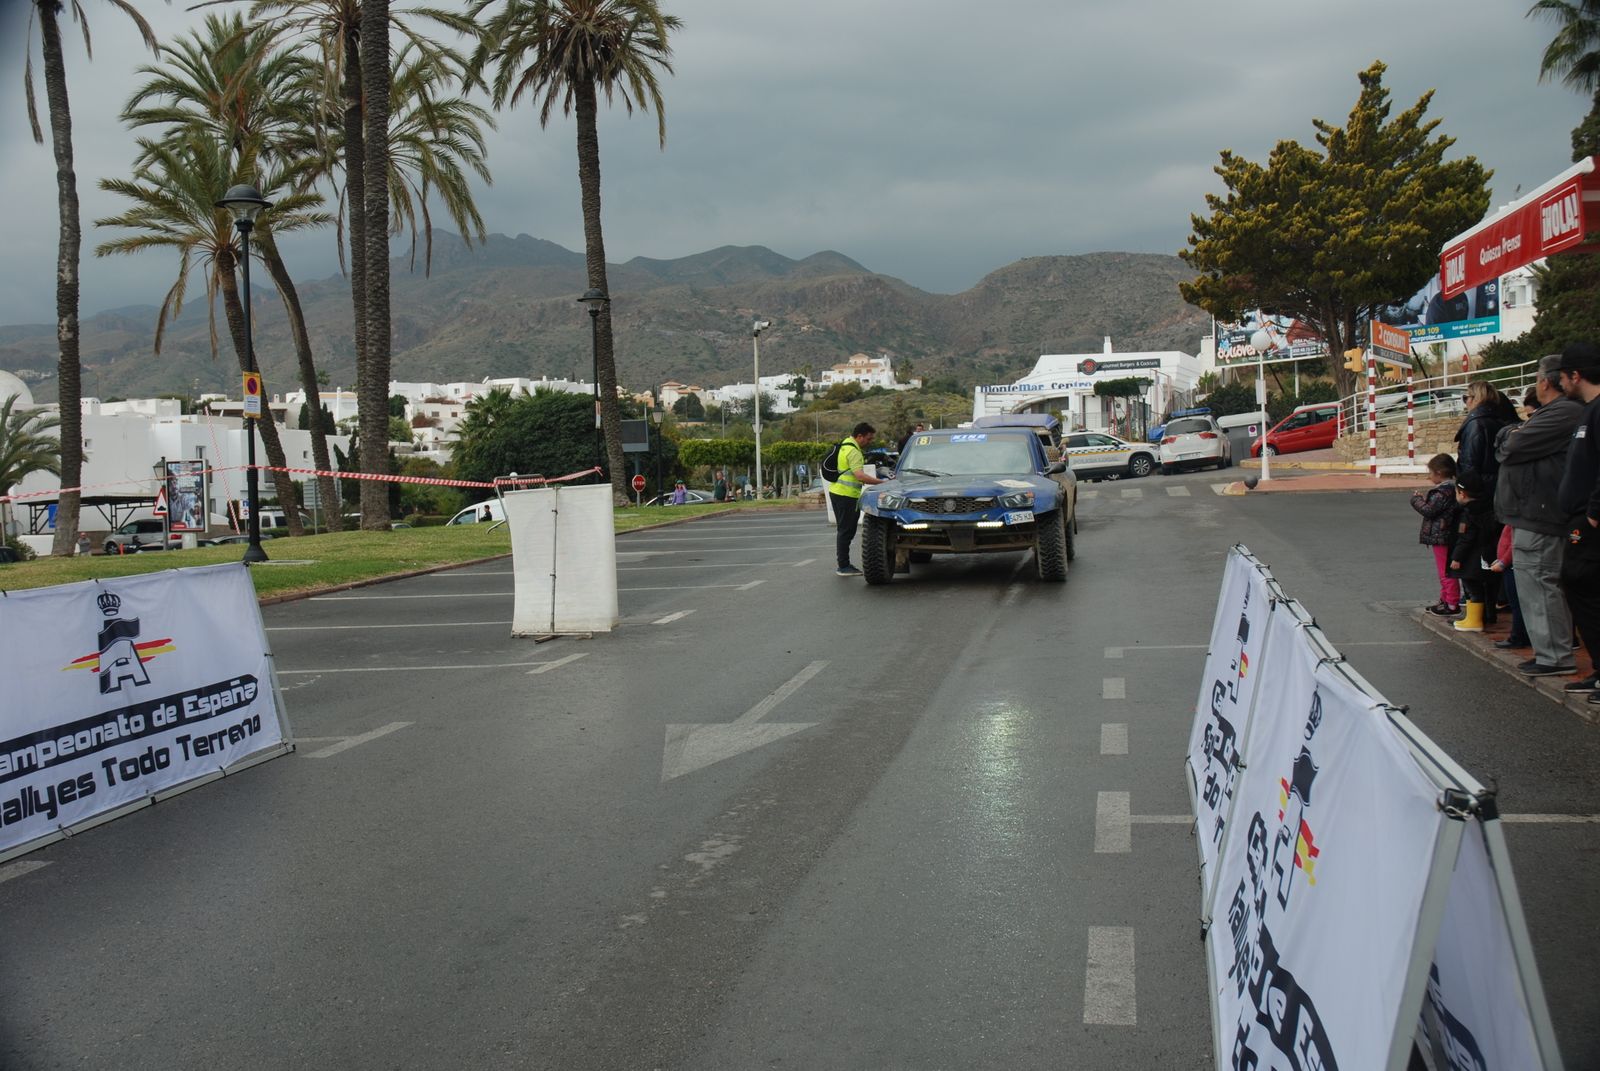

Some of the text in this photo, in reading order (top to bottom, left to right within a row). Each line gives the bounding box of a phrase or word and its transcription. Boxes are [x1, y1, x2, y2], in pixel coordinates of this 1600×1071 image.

[1542, 192, 1579, 242] ¡HOLA!
[1502, 234, 1521, 255] Prensa
[1427, 326, 1440, 334] 109
[919, 436, 928, 445] 8
[152, 703, 177, 727] de
[183, 681, 257, 719] España
[0, 714, 261, 828] allyes Todo Terreno
